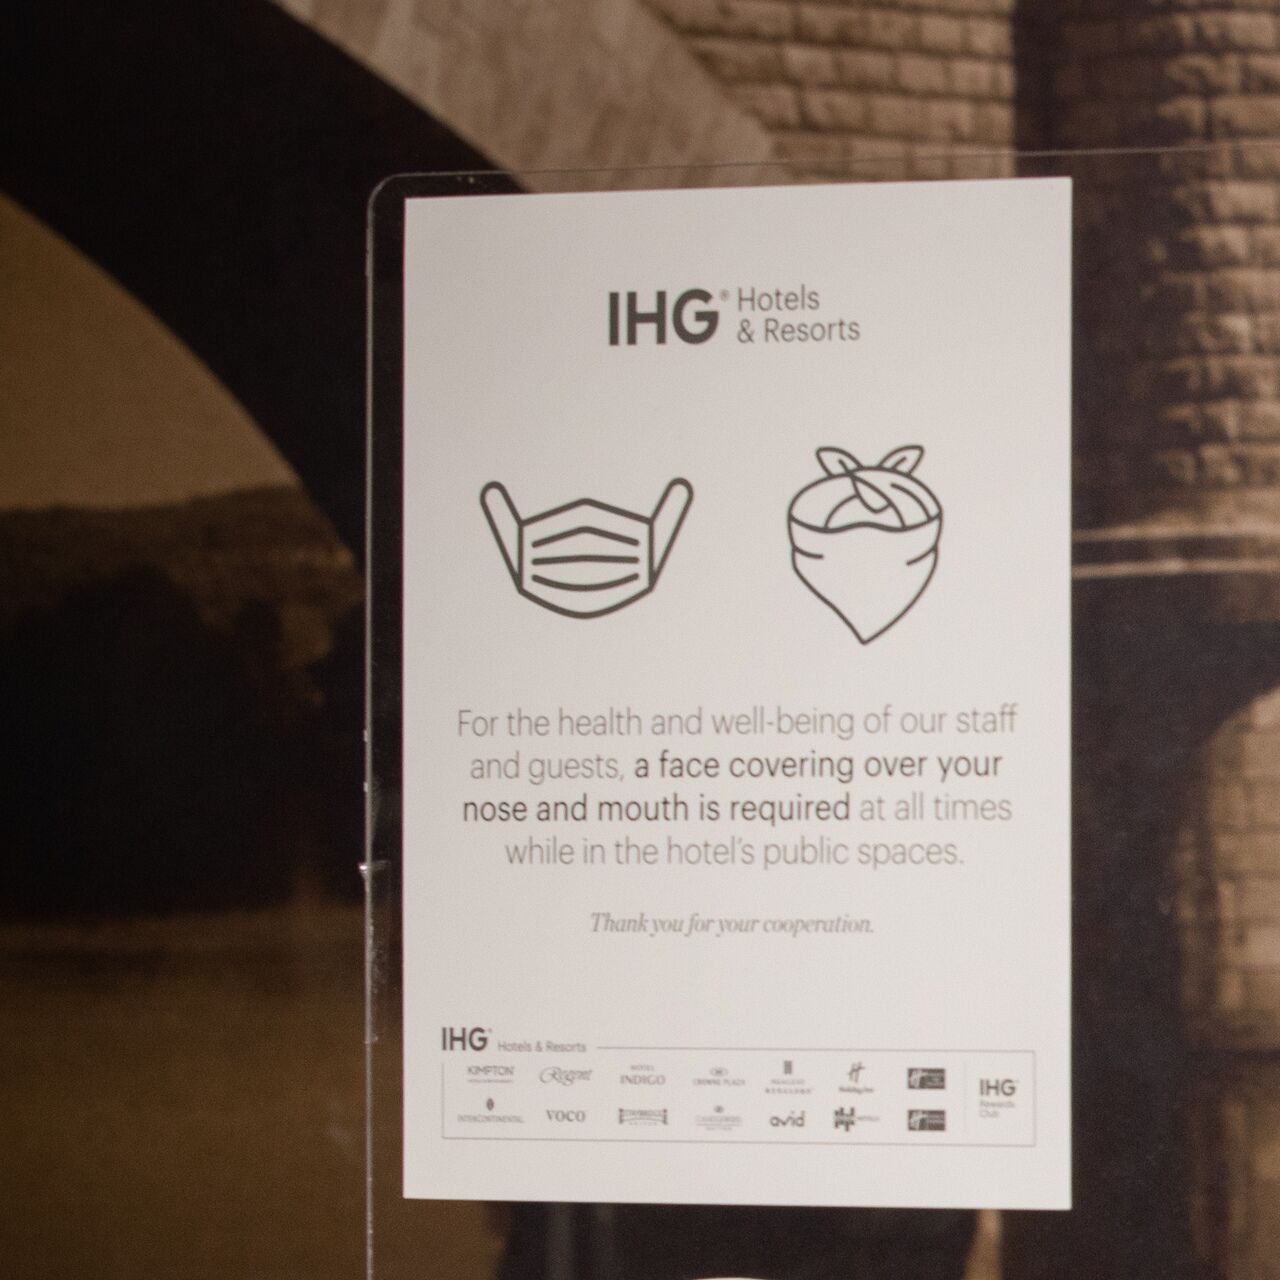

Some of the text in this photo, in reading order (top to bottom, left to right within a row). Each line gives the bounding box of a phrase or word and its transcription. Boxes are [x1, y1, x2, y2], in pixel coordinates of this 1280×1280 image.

[738, 284, 820, 311] Hotels
[737, 318, 860, 343] & Resorts
[458, 703, 1018, 741] For the health and well-being of our staff
[470, 749, 1002, 785] and guests, a face covering over your
[464, 791, 1012, 826] nose and mouth is required at all times
[505, 835, 964, 870] while in the hotel's public spaces.
[591, 912, 874, 938] Thank you for your cooperation.
[498, 1041, 532, 1052] Hotels
[535, 1041, 543, 1052] &
[546, 1041, 586, 1052] Resorts
[620, 1075, 666, 1085] INDIGO
[770, 1111, 805, 1127] avid
